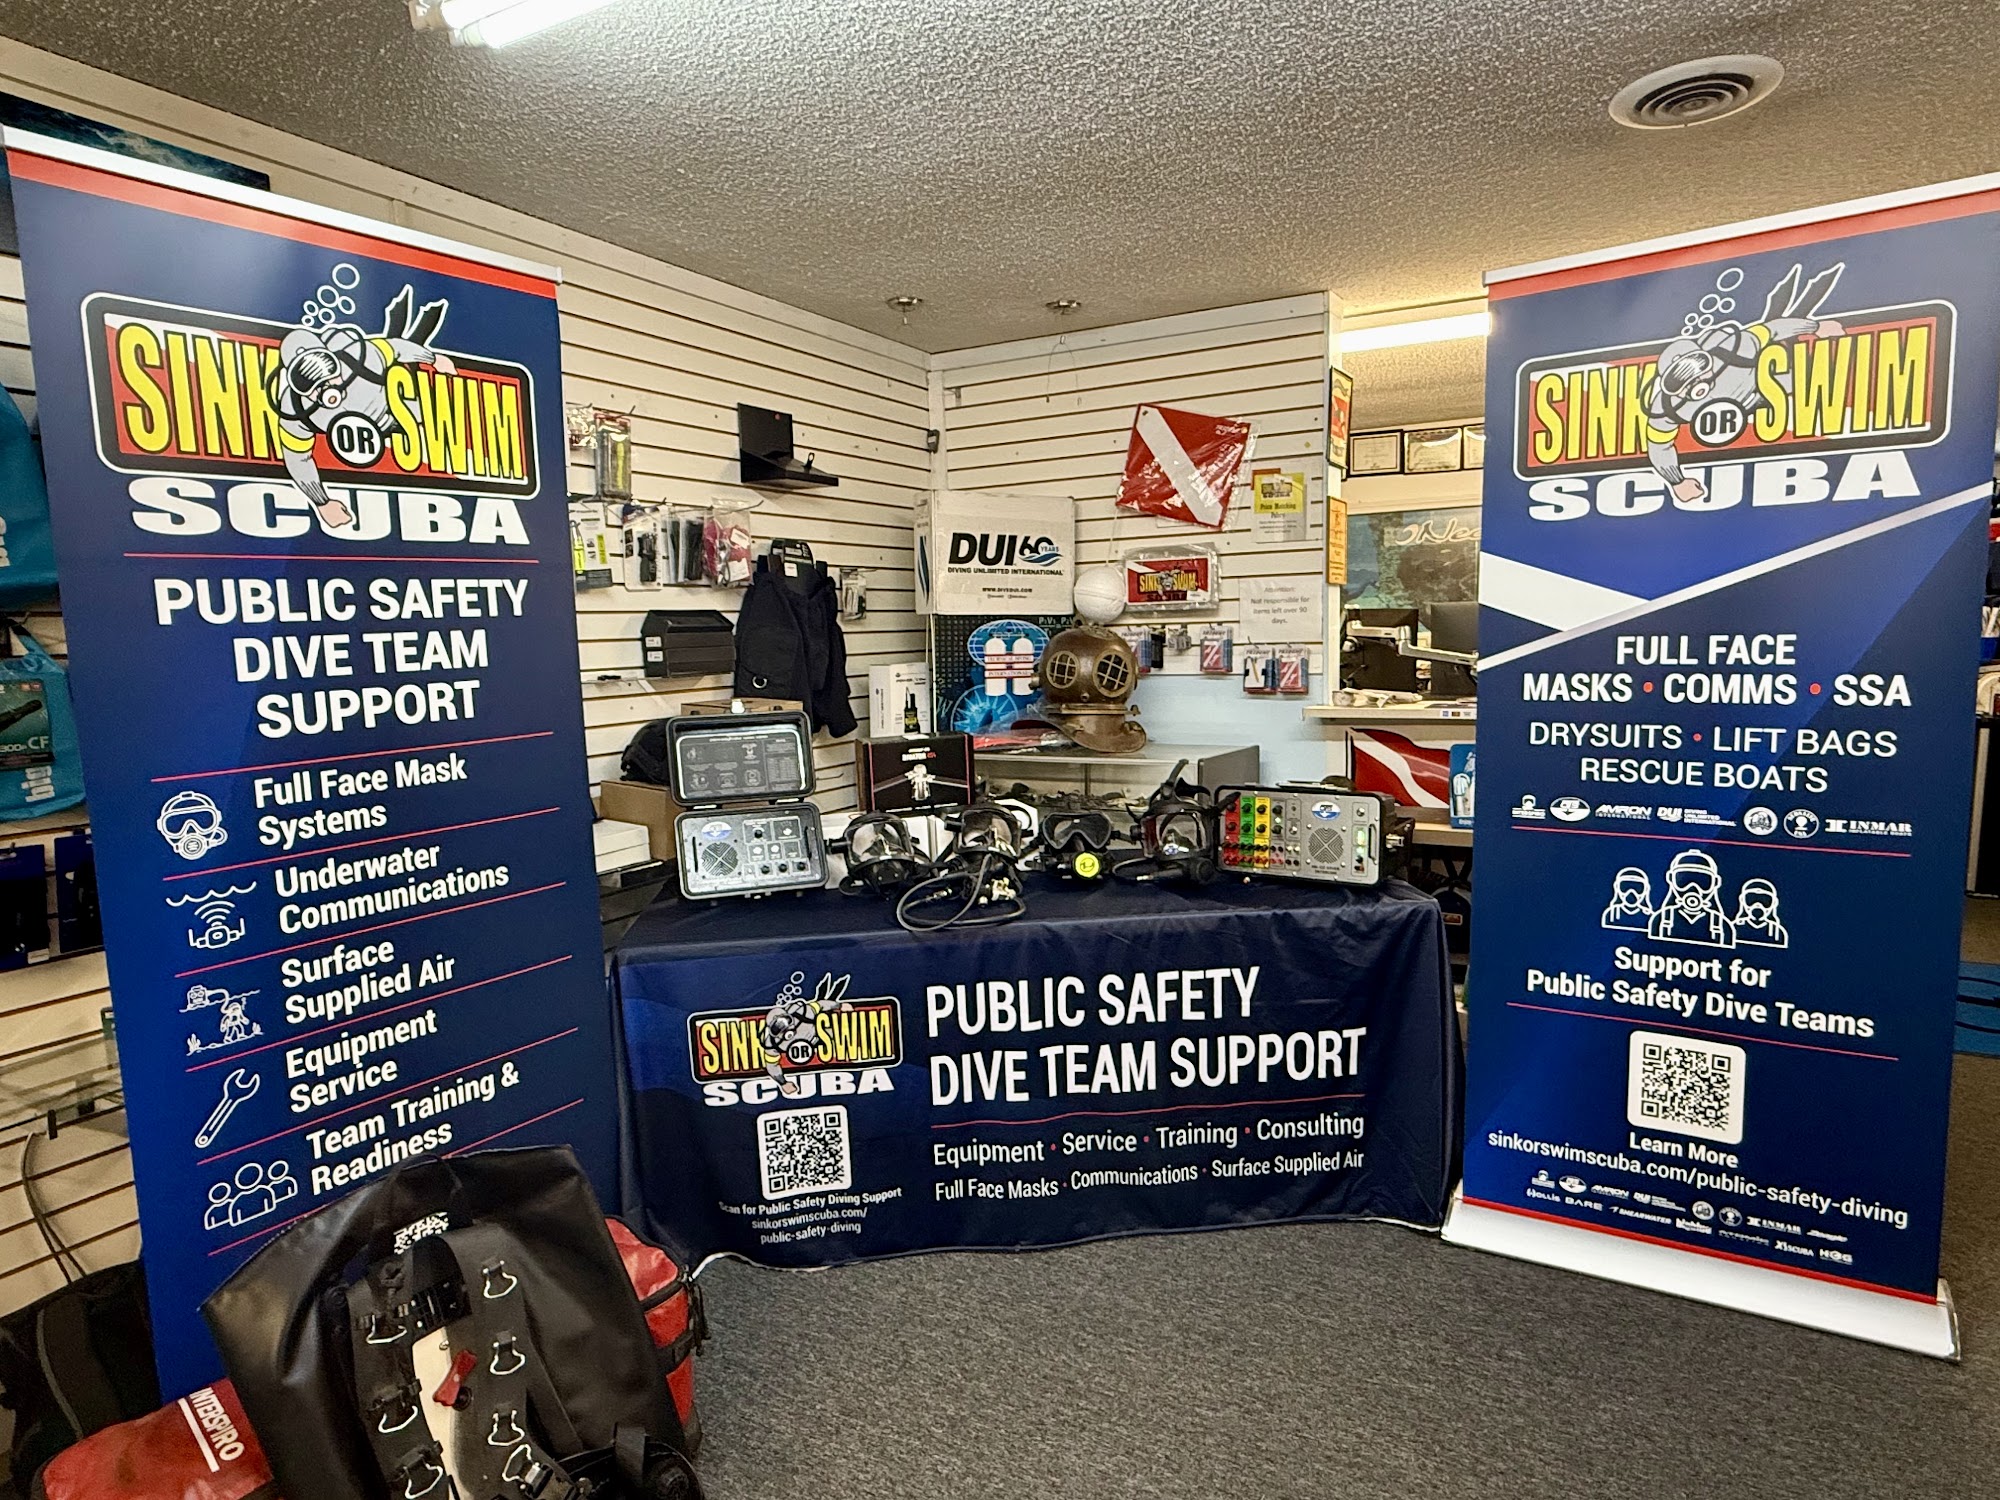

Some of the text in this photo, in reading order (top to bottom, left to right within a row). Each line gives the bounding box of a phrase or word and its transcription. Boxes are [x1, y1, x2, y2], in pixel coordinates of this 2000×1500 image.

[117, 322, 524, 480] SINK OR SWIM
[1533, 326, 1930, 465] SINK OR SWIM
[127, 477, 530, 546] SCUBA
[1528, 450, 1921, 522] SCUBA
[949, 532, 1018, 567] DUI
[973, 567, 1010, 575] UNLIMITED
[1011, 568, 1063, 576] INTERNATIONAL
[1040, 545, 1060, 553] YEARS
[153, 578, 529, 626] PUBLIC SAFETY
[233, 628, 489, 683] DIVE TEAM
[1616, 633, 1798, 666] FULL FACE
[256, 679, 481, 739] SUPPORT
[1523, 672, 1912, 707] MASKS COMMS SSA
[28, 735, 49, 749] CF
[1529, 721, 1898, 758] DRYSUITS LIFT BAGS
[254, 752, 468, 809] Full Face Mask
[1580, 757, 1828, 793] RESCUE BOATS
[258, 805, 388, 851] Systems
[1850, 820, 1912, 832] INMAR
[274, 841, 440, 898] Underwater
[278, 863, 510, 934] Communications
[281, 937, 395, 988] Surface
[285, 954, 455, 1024] Supplied Air
[1614, 946, 1772, 988] Support for
[926, 965, 1260, 1038] PUBLIC SAFETY
[1527, 968, 1875, 1038] Public Safety Dive Teams
[286, 1008, 438, 1078] Equipment
[701, 1008, 893, 1075] SINK OR SWIM
[930, 1026, 1367, 1106] DIVE TEAM SUPPORT
[289, 1060, 398, 1113] Service
[306, 1061, 520, 1160] Team Training &
[702, 1068, 895, 1107] SCUBA
[311, 1122, 454, 1196] Readiness
[933, 1111, 1364, 1169] Equipment Service Training Consulting
[1629, 1131, 1739, 1169] Learn More
[742, 1203, 757, 1216] for
[758, 1202, 792, 1216] Public
[792, 1196, 826, 1210] Safety
[828, 1193, 861, 1206] Diving
[862, 1187, 902, 1204] Support
[935, 1151, 1365, 1201] Full Face Masks Communications Surface Supplied Air
[1488, 1130, 1909, 1231] sinkorswimscuba.com/public-safety-diving
[751, 1206, 868, 1230] sinkorswimscuba.com/
[760, 1221, 861, 1245] public-safety-diving
[190, 1386, 246, 1463] INTERSPIRO
